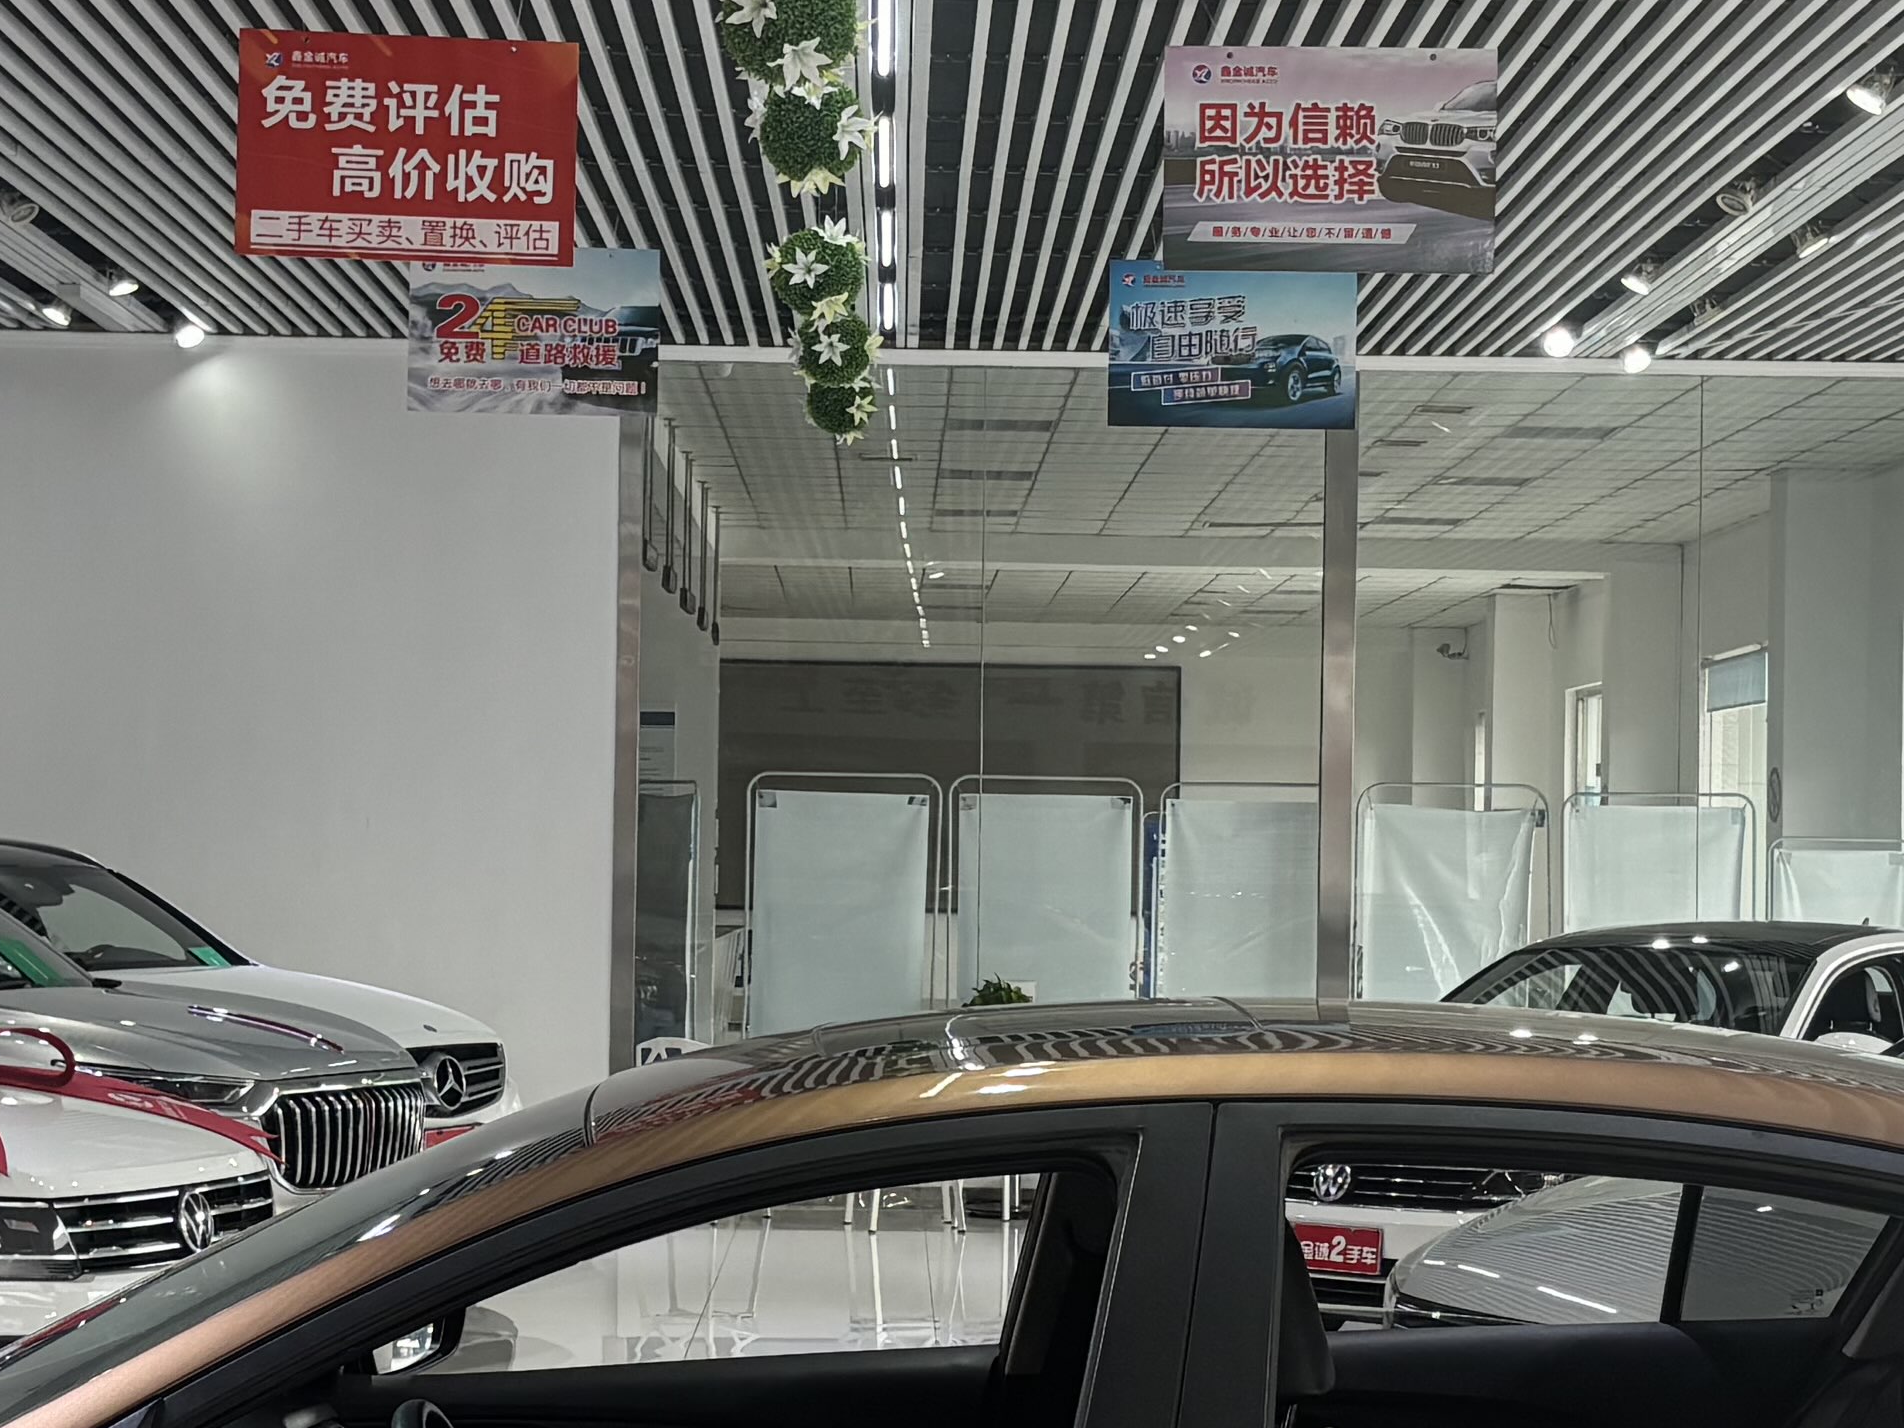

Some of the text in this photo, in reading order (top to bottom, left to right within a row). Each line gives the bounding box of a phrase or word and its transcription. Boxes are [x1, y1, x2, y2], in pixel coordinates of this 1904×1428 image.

[260, 75, 500, 138] 免费评估
[1199, 101, 1376, 146] 因为信赖
[331, 144, 555, 205] 高价收购
[1197, 157, 1376, 203] 所以选择
[256, 214, 552, 253] 二手车买卖、置换、评估
[515, 315, 619, 336] CAR CLUB
[1130, 295, 1246, 331] 极速享受
[438, 341, 619, 367] 免费 道路救援
[1150, 326, 1257, 362] 自由随行
